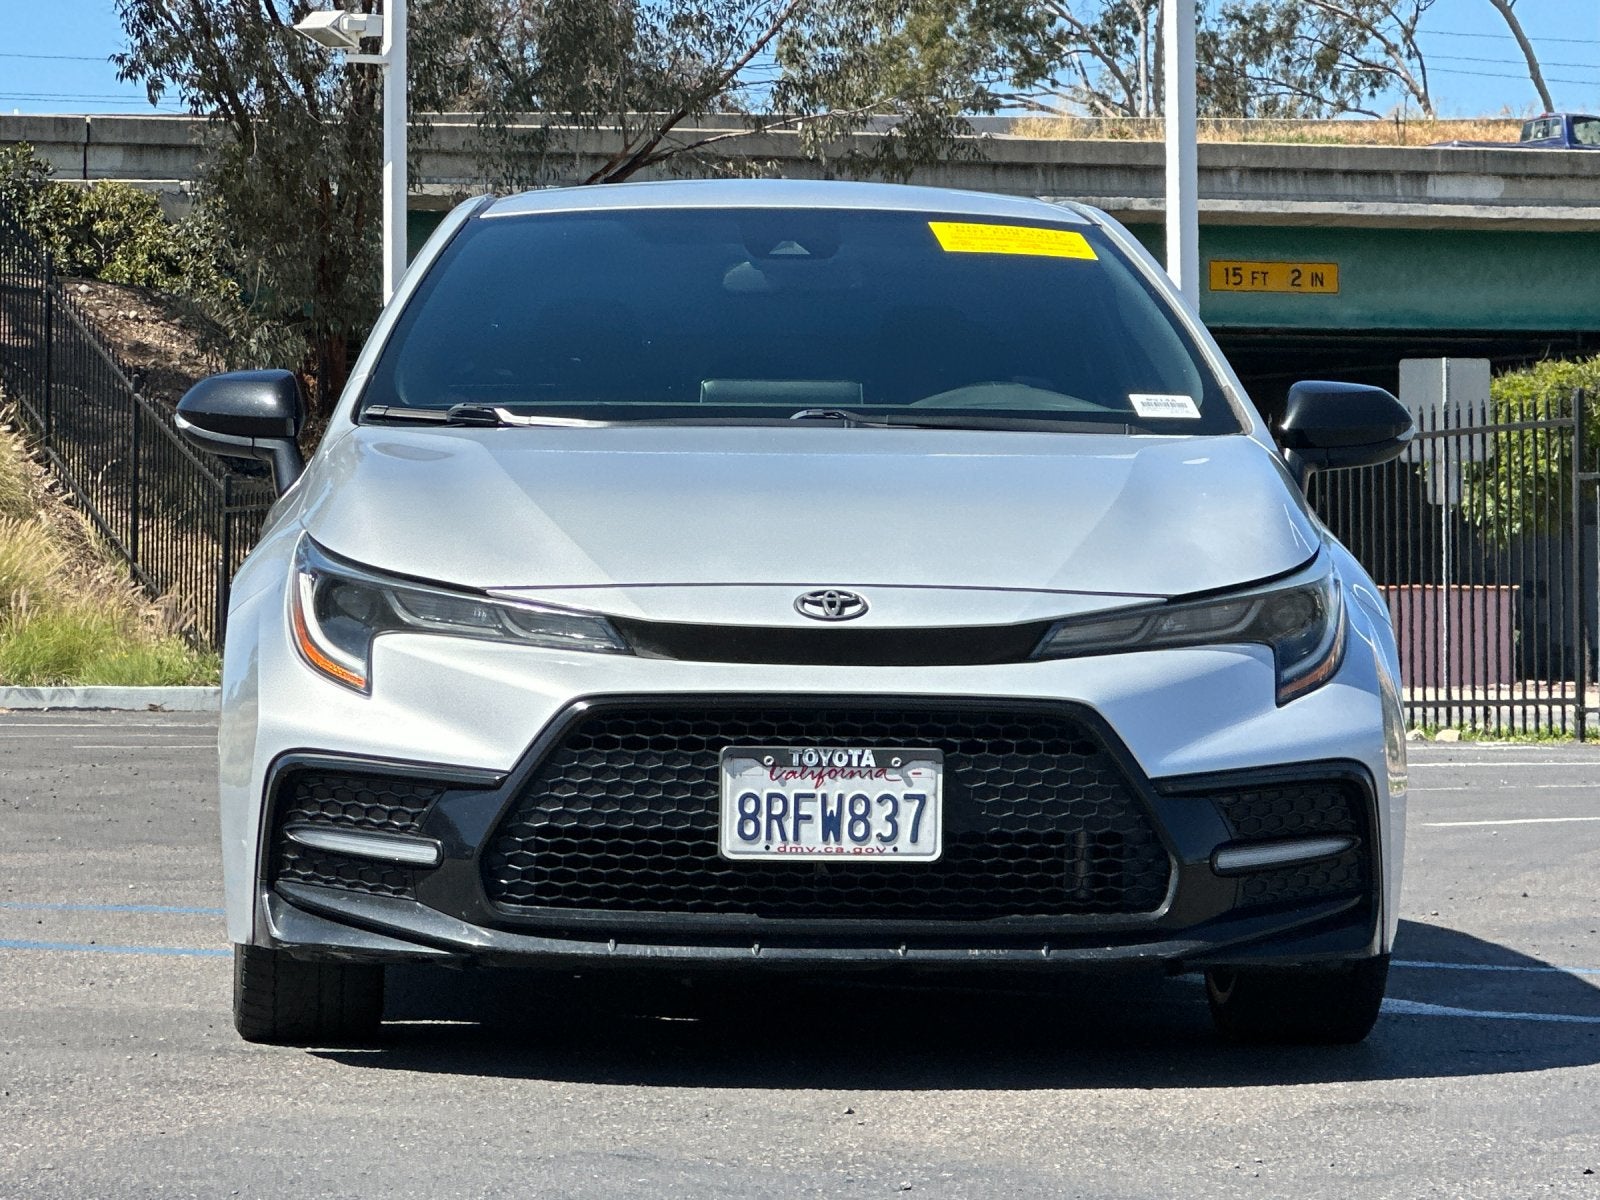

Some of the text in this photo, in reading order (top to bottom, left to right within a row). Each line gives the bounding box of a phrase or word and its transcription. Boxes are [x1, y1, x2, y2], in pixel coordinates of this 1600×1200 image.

[1224, 267, 1324, 287] 15 FT 2 IN
[789, 748, 877, 767] TOYOTA
[768, 764, 903, 789] California
[737, 792, 927, 844] 8RFW837
[777, 844, 887, 855] dmv.ca.gov
